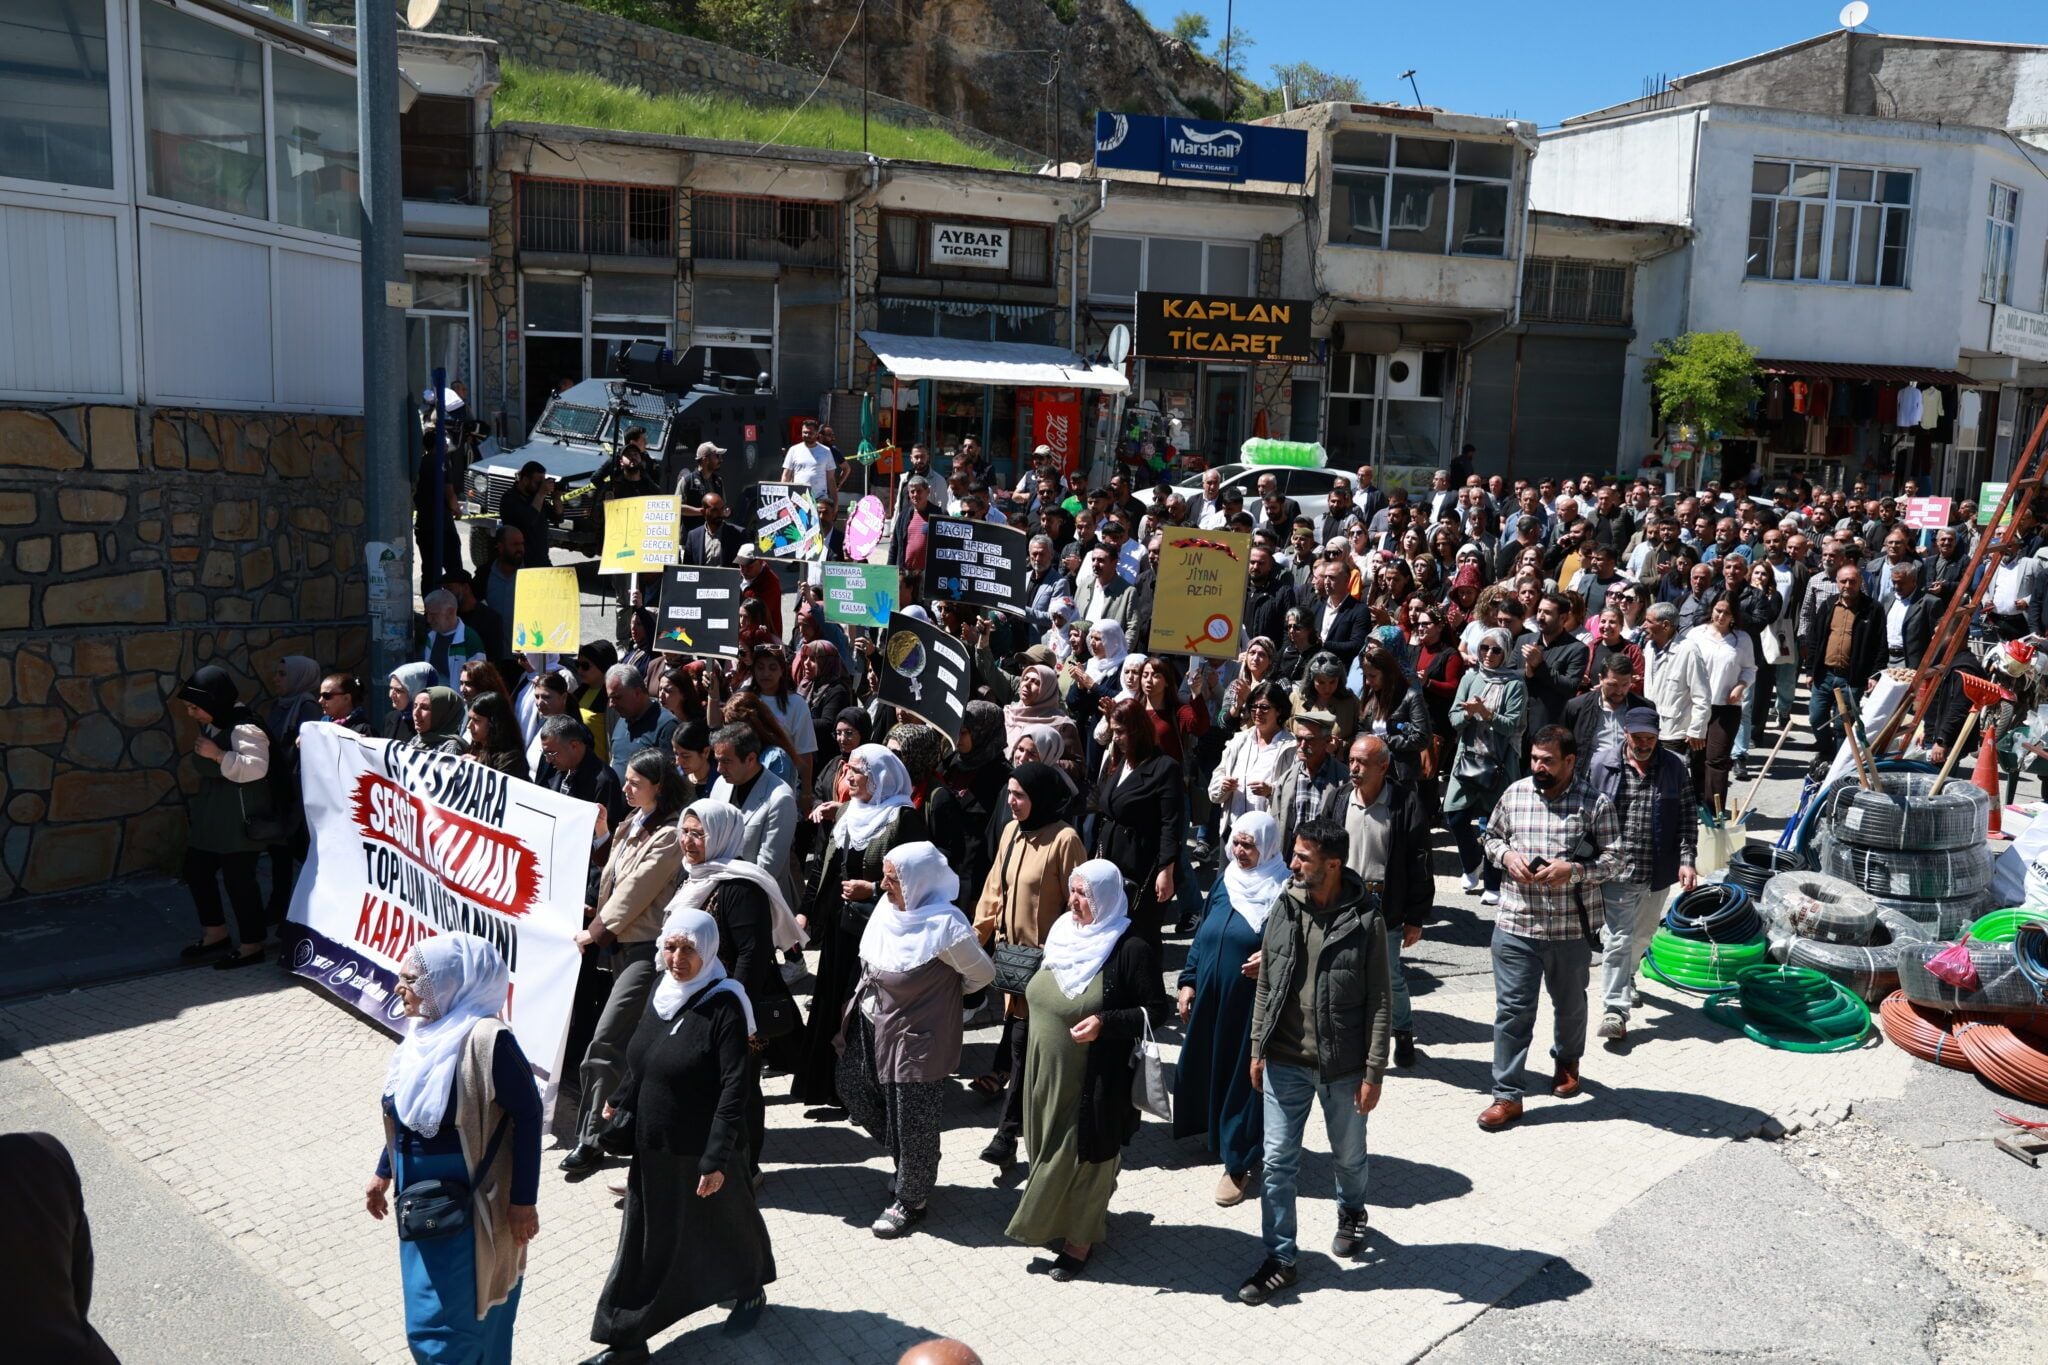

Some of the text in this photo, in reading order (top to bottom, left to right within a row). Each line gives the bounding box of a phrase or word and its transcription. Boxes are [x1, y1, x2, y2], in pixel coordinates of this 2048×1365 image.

[1170, 138, 1234, 158] Marshall
[1180, 162, 1203, 170] YILMAZ
[939, 230, 1003, 247] AYBAR
[1163, 299, 1290, 324] KAPLAN
[1168, 326, 1283, 354] TİCARET
[647, 501, 671, 510] ERKEK
[643, 539, 673, 551] GERÇEK
[964, 540, 1001, 555] HERKES
[937, 549, 1011, 569] DUYSUN ERKEK
[975, 580, 1011, 596] BULSUN
[368, 782, 522, 906] SESSİZ KALMAK
[362, 841, 428, 917] TOPLUM
